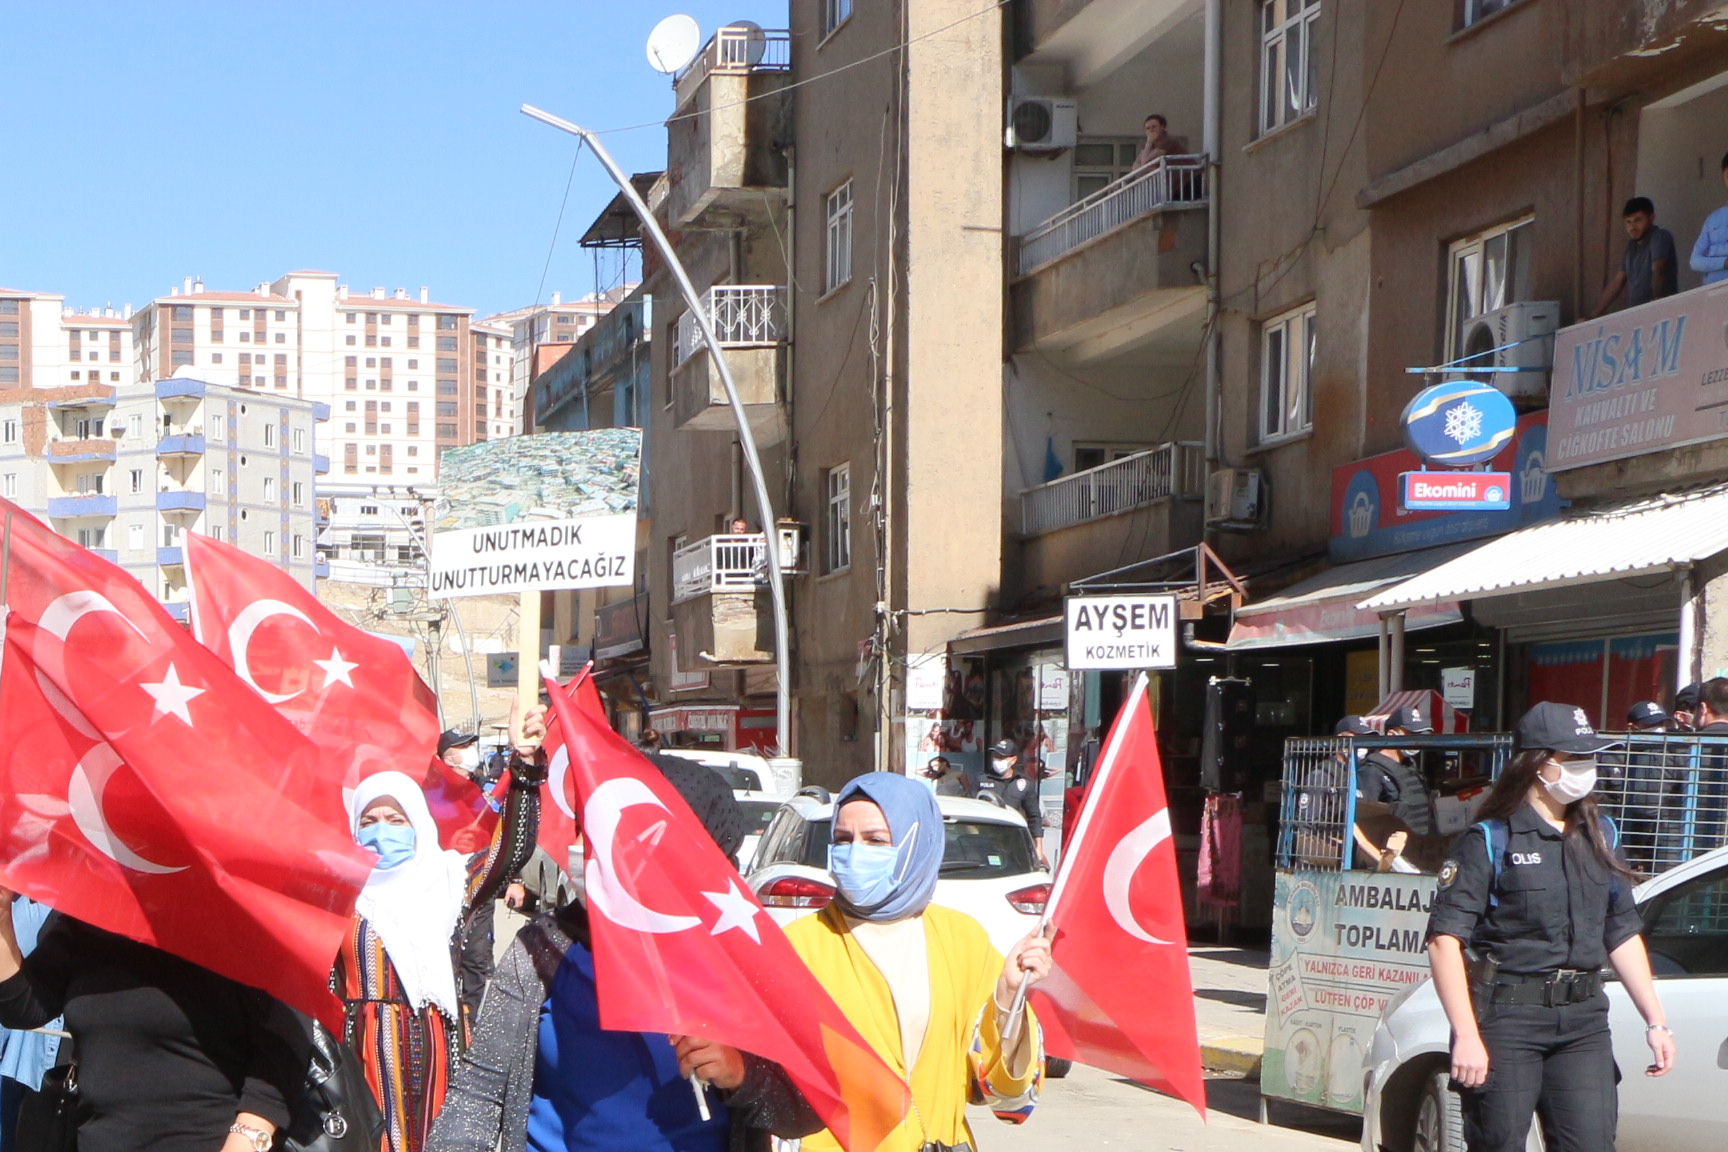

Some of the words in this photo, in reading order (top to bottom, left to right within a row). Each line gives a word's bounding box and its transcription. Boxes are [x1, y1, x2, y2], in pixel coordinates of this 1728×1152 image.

[1574, 393, 1636, 428] KAHVALTI
[1640, 388, 1658, 412] VE
[1621, 415, 1675, 447] SALONU
[1414, 482, 1477, 498] Ekomini
[473, 524, 582, 554] UNUTMADIK
[431, 551, 626, 593] UNUTTURMAYACAĞIZ
[1074, 603, 1169, 638] AYŞEM
[1085, 641, 1161, 659] KOZMETİK
[1334, 884, 1437, 914] AMBALAJ
[1275, 964, 1294, 982] ÇÖPE
[1304, 959, 1350, 980] YALNIZCA
[1352, 962, 1376, 980] GERİ
[1278, 975, 1296, 992] ATMA
[1281, 986, 1297, 1003] GERİ
[1354, 993, 1375, 1011] ÇÖP
[1280, 996, 1304, 1017] KAZAN
